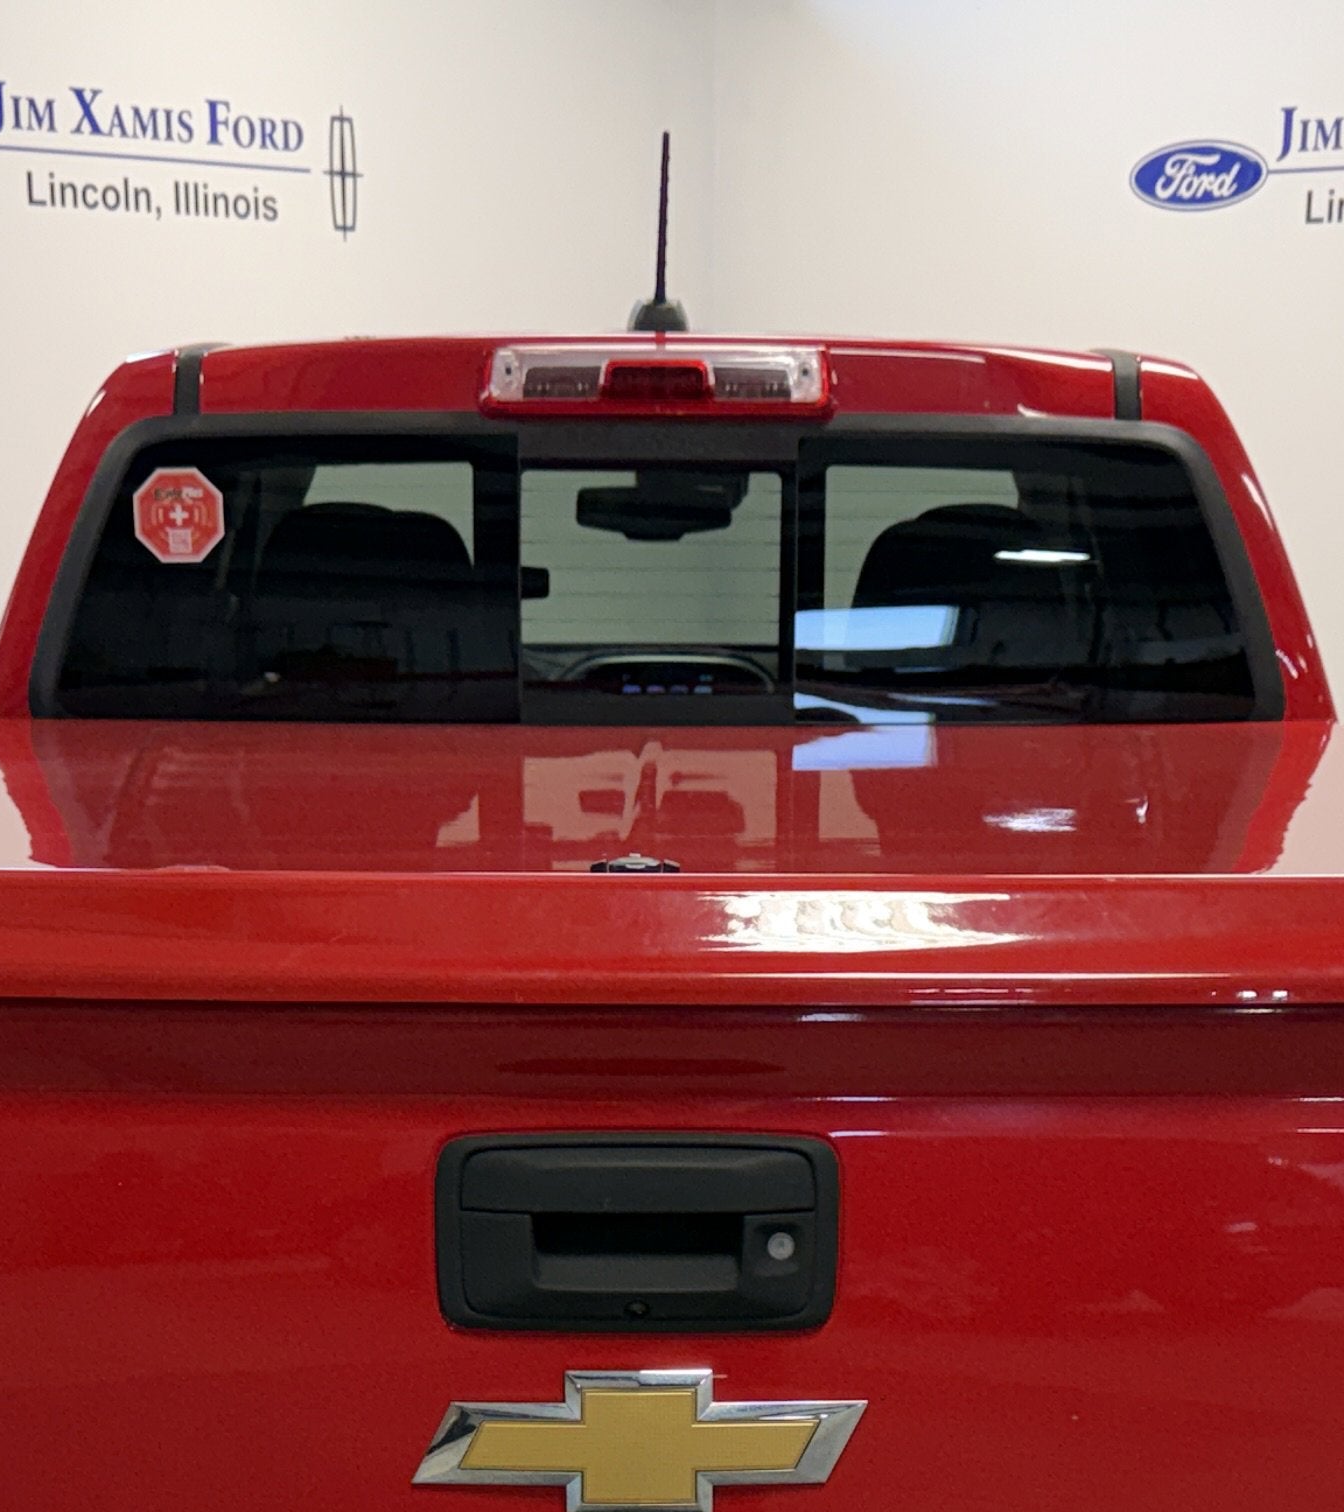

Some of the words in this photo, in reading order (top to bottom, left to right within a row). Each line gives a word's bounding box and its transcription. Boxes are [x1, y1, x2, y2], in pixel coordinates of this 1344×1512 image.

[26, 170, 162, 220] Lincoln,
[173, 180, 279, 222] Illinois
[1154, 152, 1239, 200] Ford
